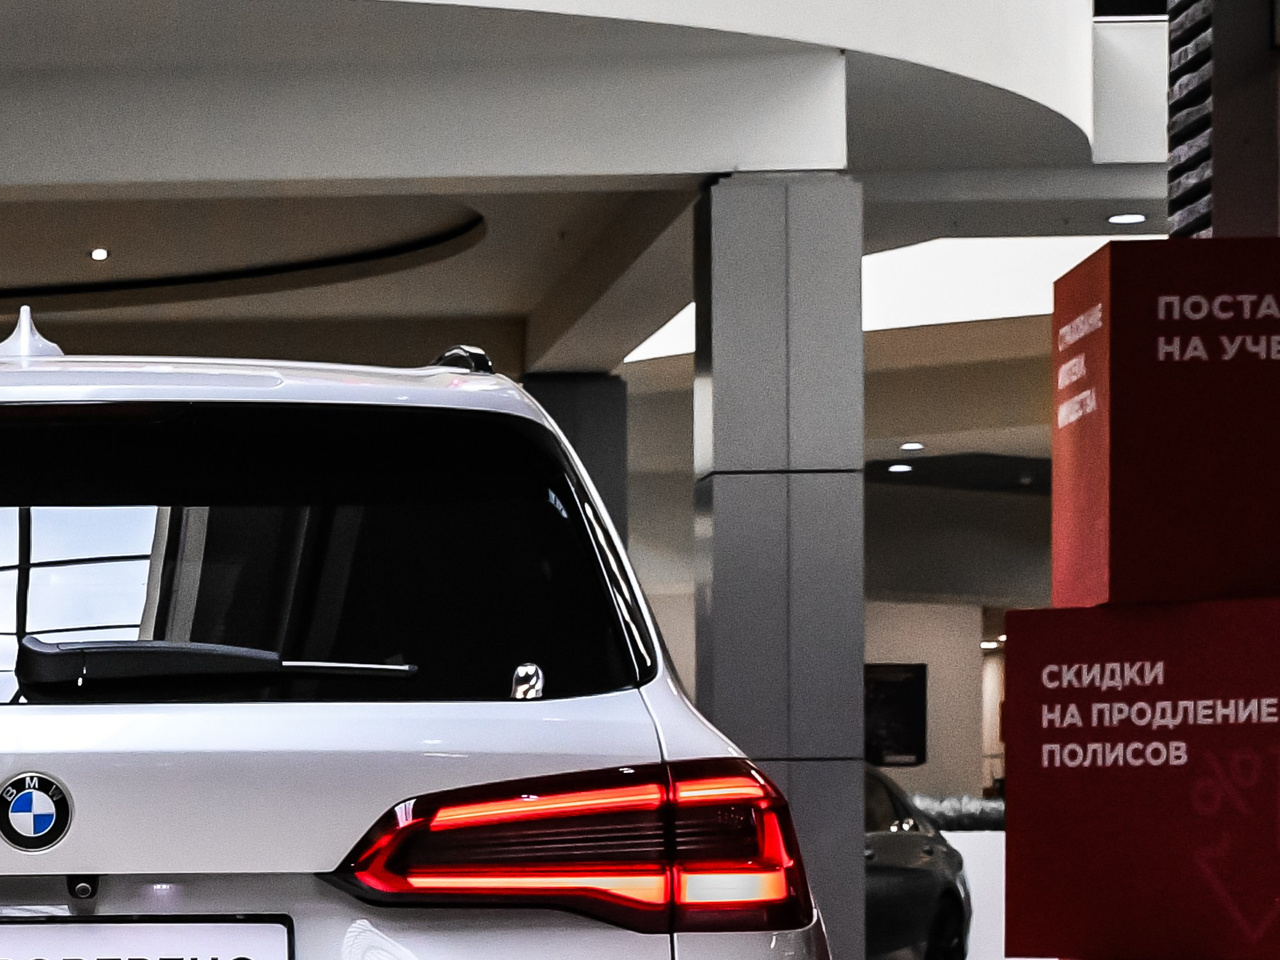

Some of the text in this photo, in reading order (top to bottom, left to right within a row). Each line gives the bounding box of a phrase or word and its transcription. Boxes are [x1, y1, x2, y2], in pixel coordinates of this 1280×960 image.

[1157, 294, 1280, 320] ПОСТА
[1157, 336, 1209, 361] НА
[1041, 661, 1165, 692] СКИДКИ
[1041, 697, 1279, 730] НА ПРОДЛЕНИЕ
[1041, 741, 1188, 768] ПОЛИСОВ
[2, 776, 64, 802] BMW
